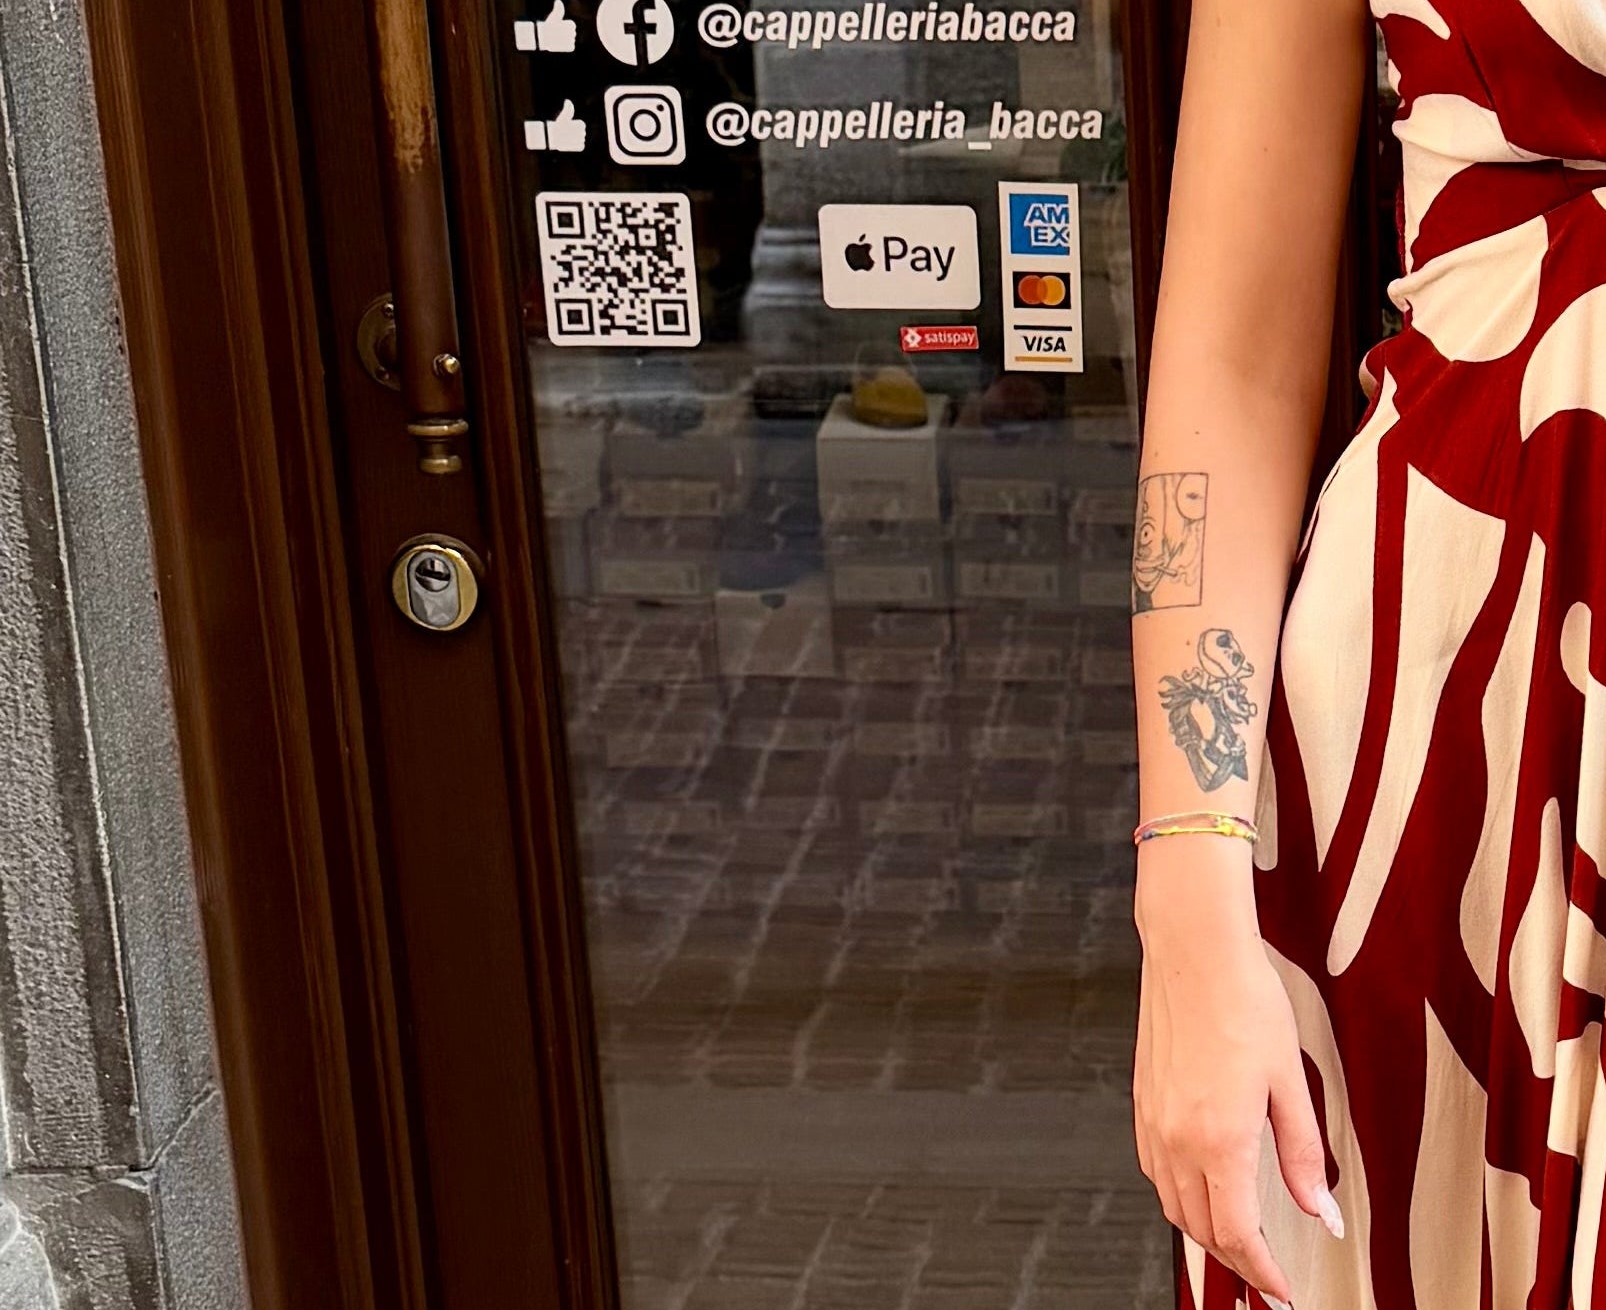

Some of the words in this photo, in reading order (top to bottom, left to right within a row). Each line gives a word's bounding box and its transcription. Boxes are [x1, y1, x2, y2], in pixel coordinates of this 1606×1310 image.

[697, 1, 1076, 50] @cappelleriabacca
[706, 100, 1103, 151] @cappelleria_bacca
[883, 235, 956, 282] Pay
[923, 330, 976, 346] satispay
[1022, 335, 1067, 353] VISA
